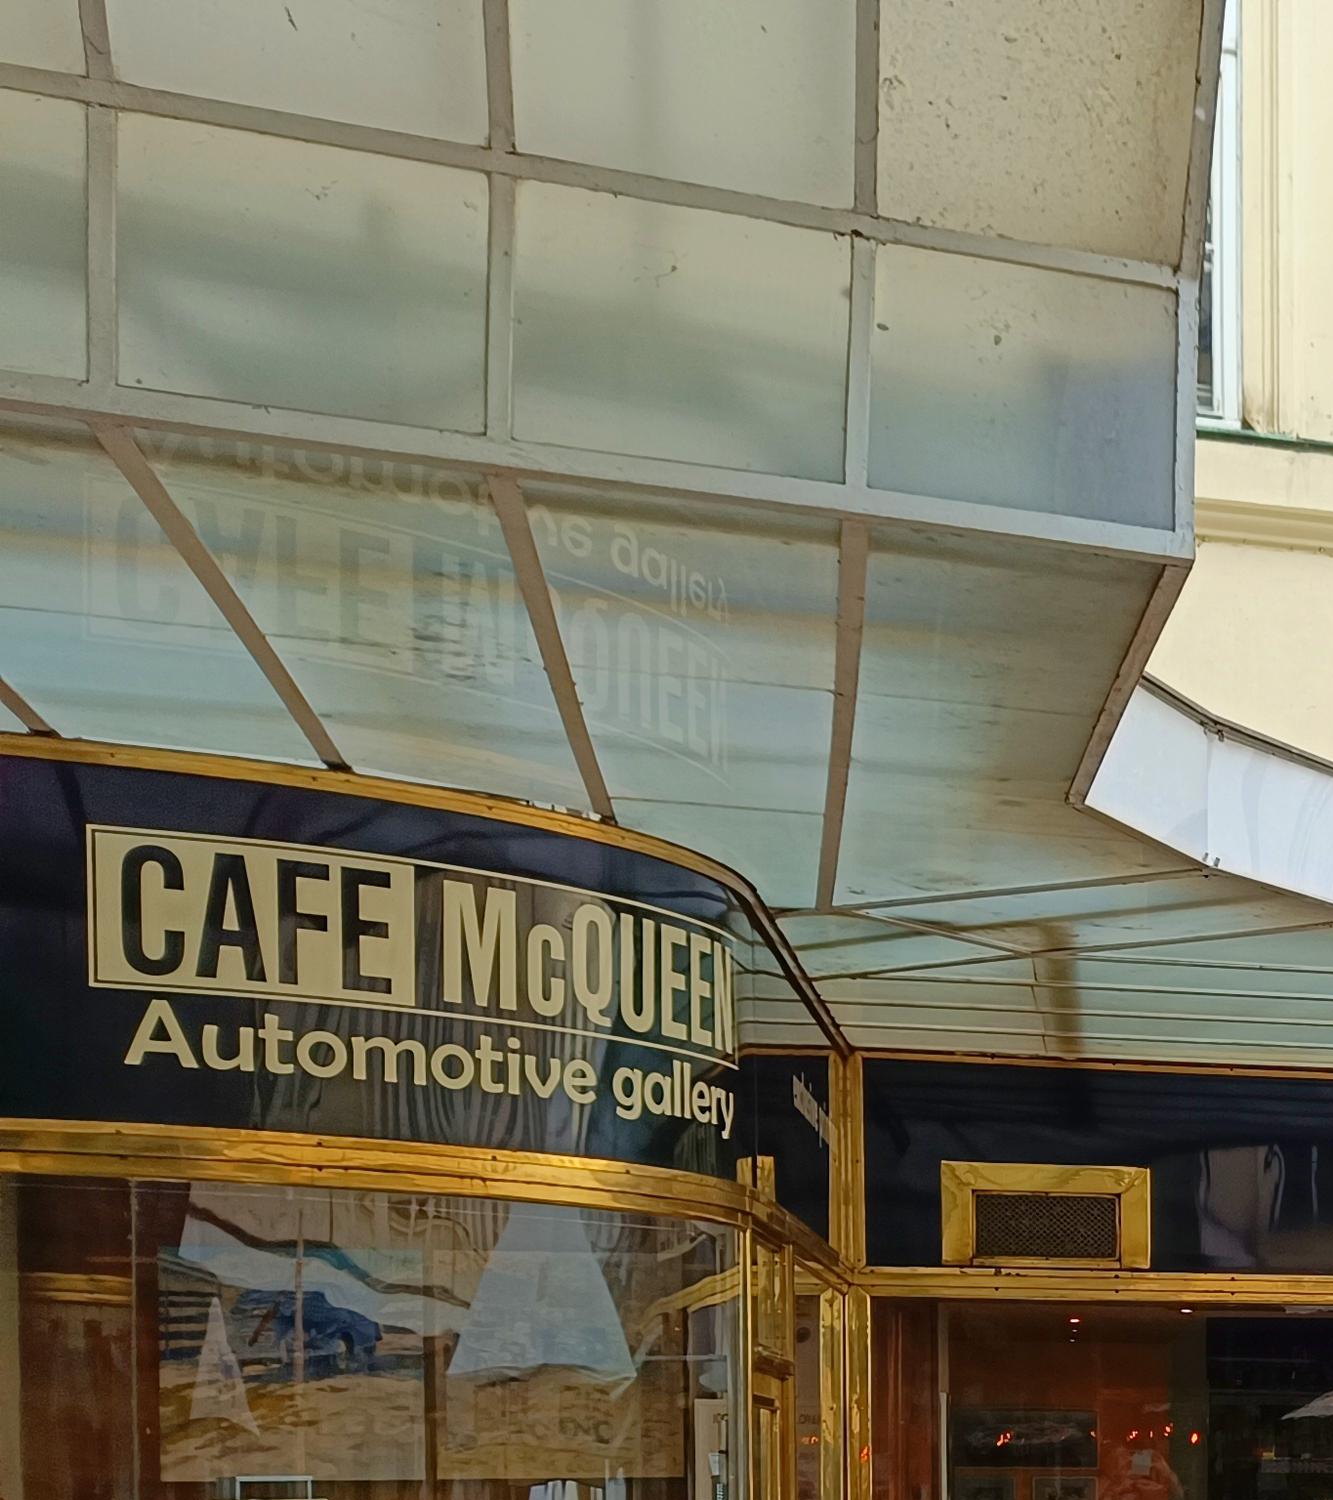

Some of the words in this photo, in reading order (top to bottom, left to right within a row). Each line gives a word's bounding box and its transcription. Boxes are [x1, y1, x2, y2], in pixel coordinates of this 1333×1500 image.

[121, 844, 394, 995] CAFE
[441, 878, 734, 1055] McQUEEN
[125, 1000, 598, 1105] Automotive
[612, 1060, 735, 1140] gallery
